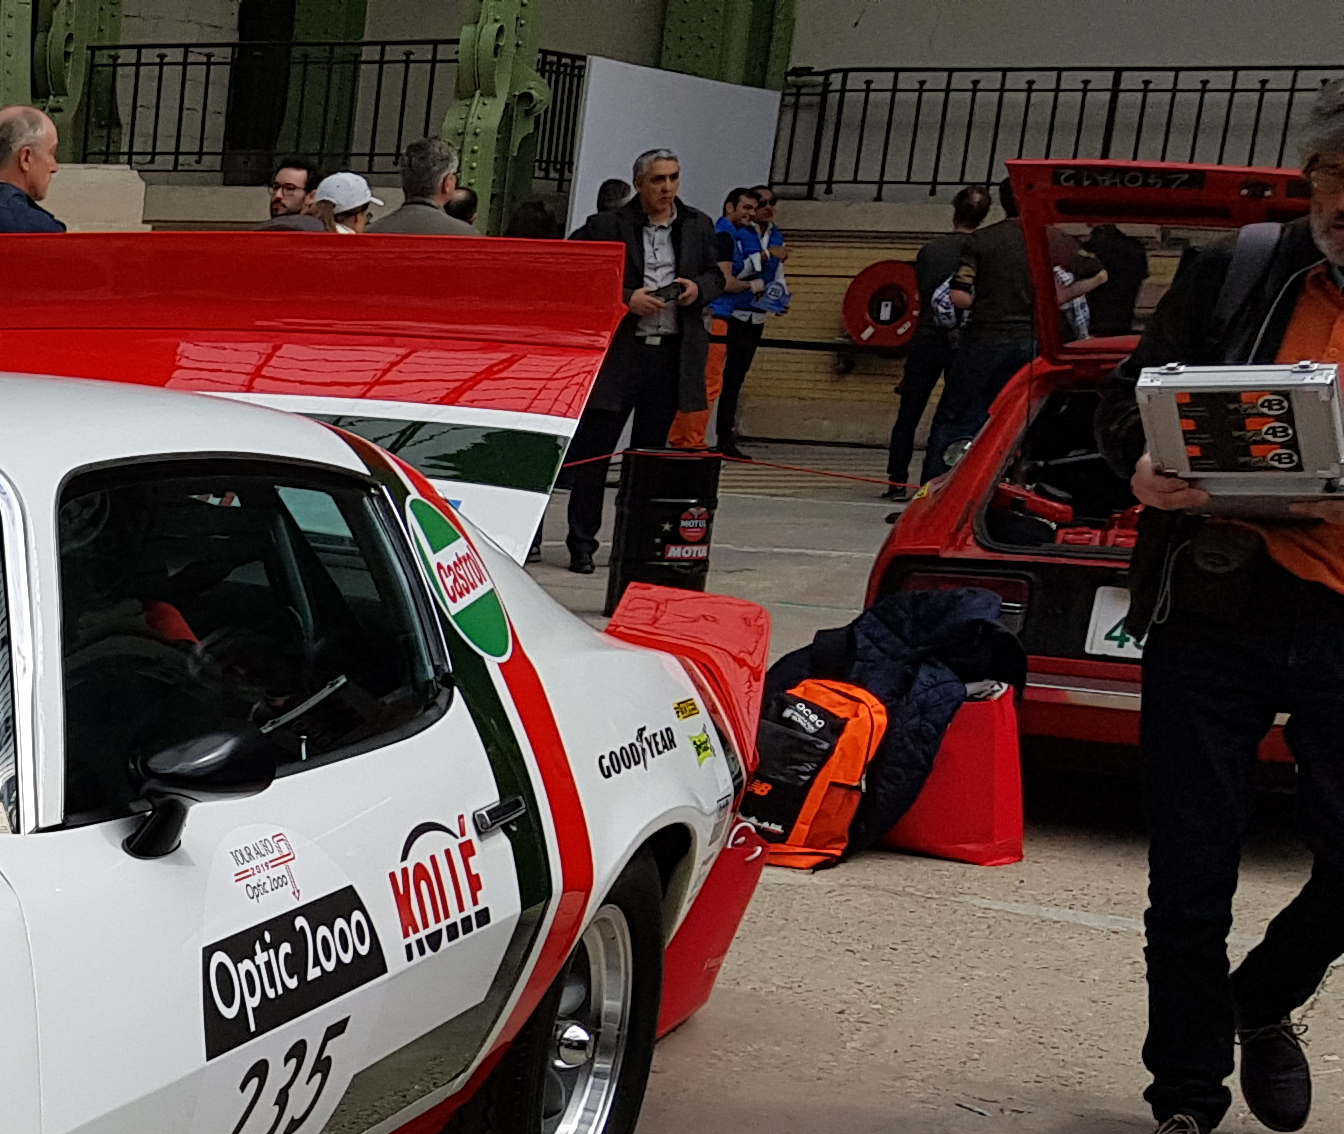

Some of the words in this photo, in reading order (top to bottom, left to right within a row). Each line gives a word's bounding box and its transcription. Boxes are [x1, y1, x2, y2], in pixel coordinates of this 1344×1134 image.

[436, 544, 488, 605] Castrol
[230, 845, 256, 867] TOUR
[252, 838, 275, 859] AUTO
[245, 879, 270, 904] Optic
[266, 874, 289, 892] 2000
[208, 929, 299, 1033] Optic
[293, 908, 372, 982] 2000
